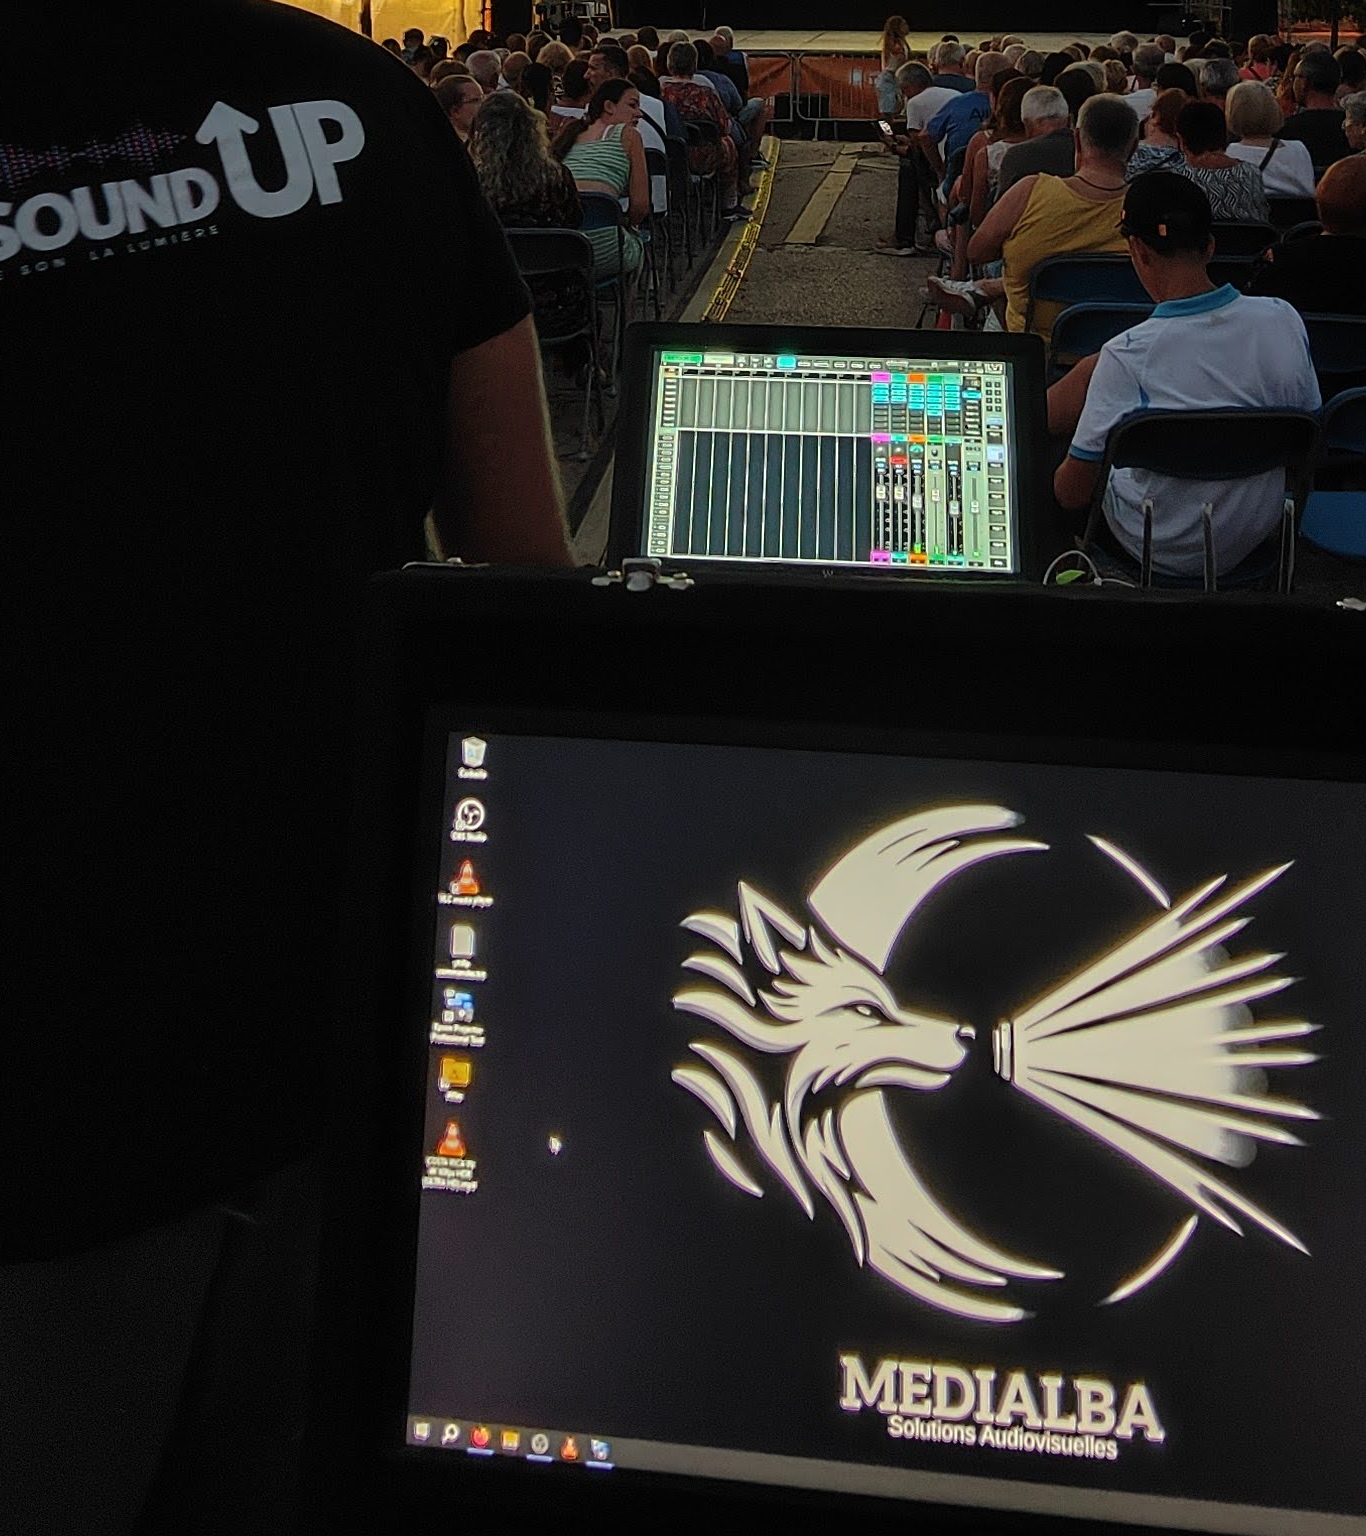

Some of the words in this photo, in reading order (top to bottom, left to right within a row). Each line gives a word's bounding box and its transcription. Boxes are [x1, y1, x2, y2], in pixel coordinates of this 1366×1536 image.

[195, 99, 365, 218] UP
[839, 1354, 1165, 1444] MEDIALBA
[887, 1415, 976, 1446] Solutions
[978, 1424, 1119, 1461] Audiovisuelles
